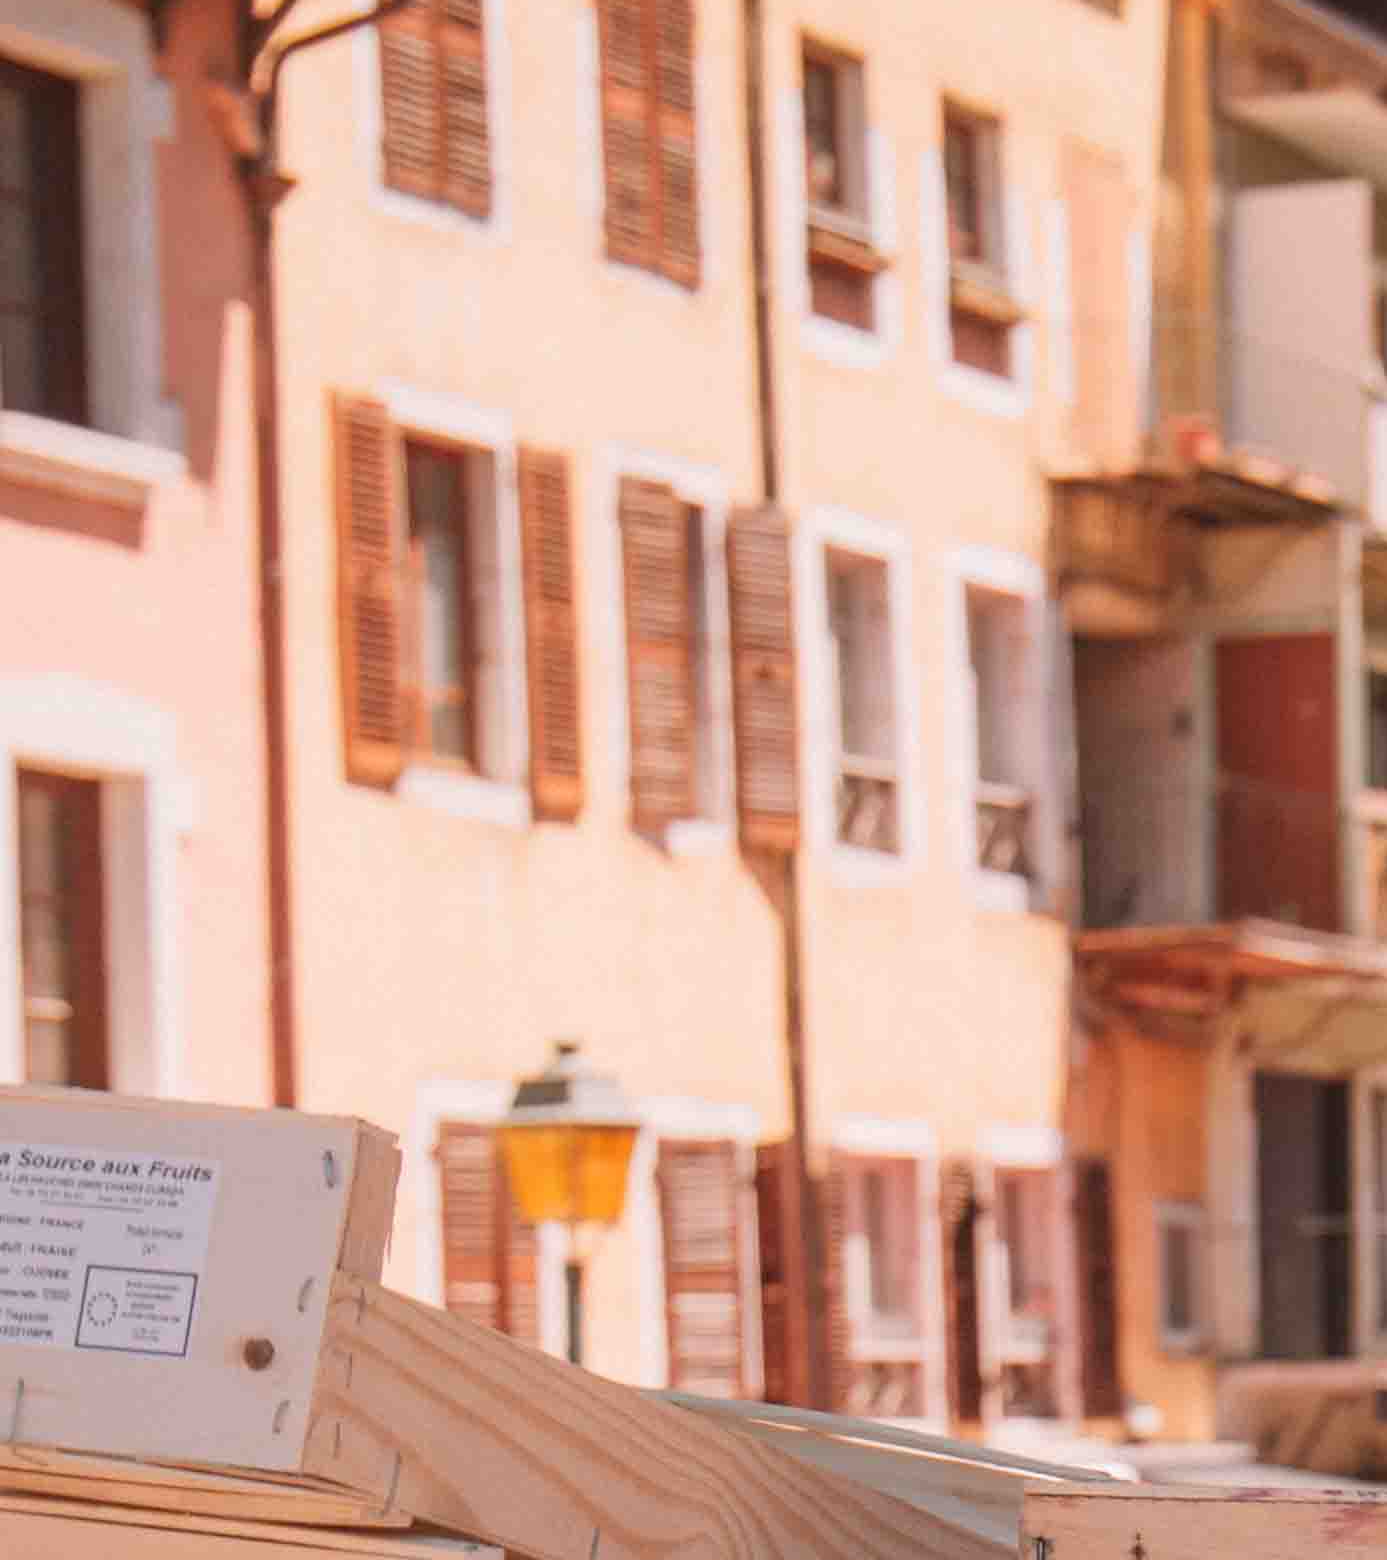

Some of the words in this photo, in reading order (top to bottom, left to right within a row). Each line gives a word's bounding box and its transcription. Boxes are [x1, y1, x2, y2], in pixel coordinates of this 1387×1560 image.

[18, 1148, 96, 1172] Source
[102, 1160, 141, 1176] aux
[148, 1160, 213, 1182] Fruits
